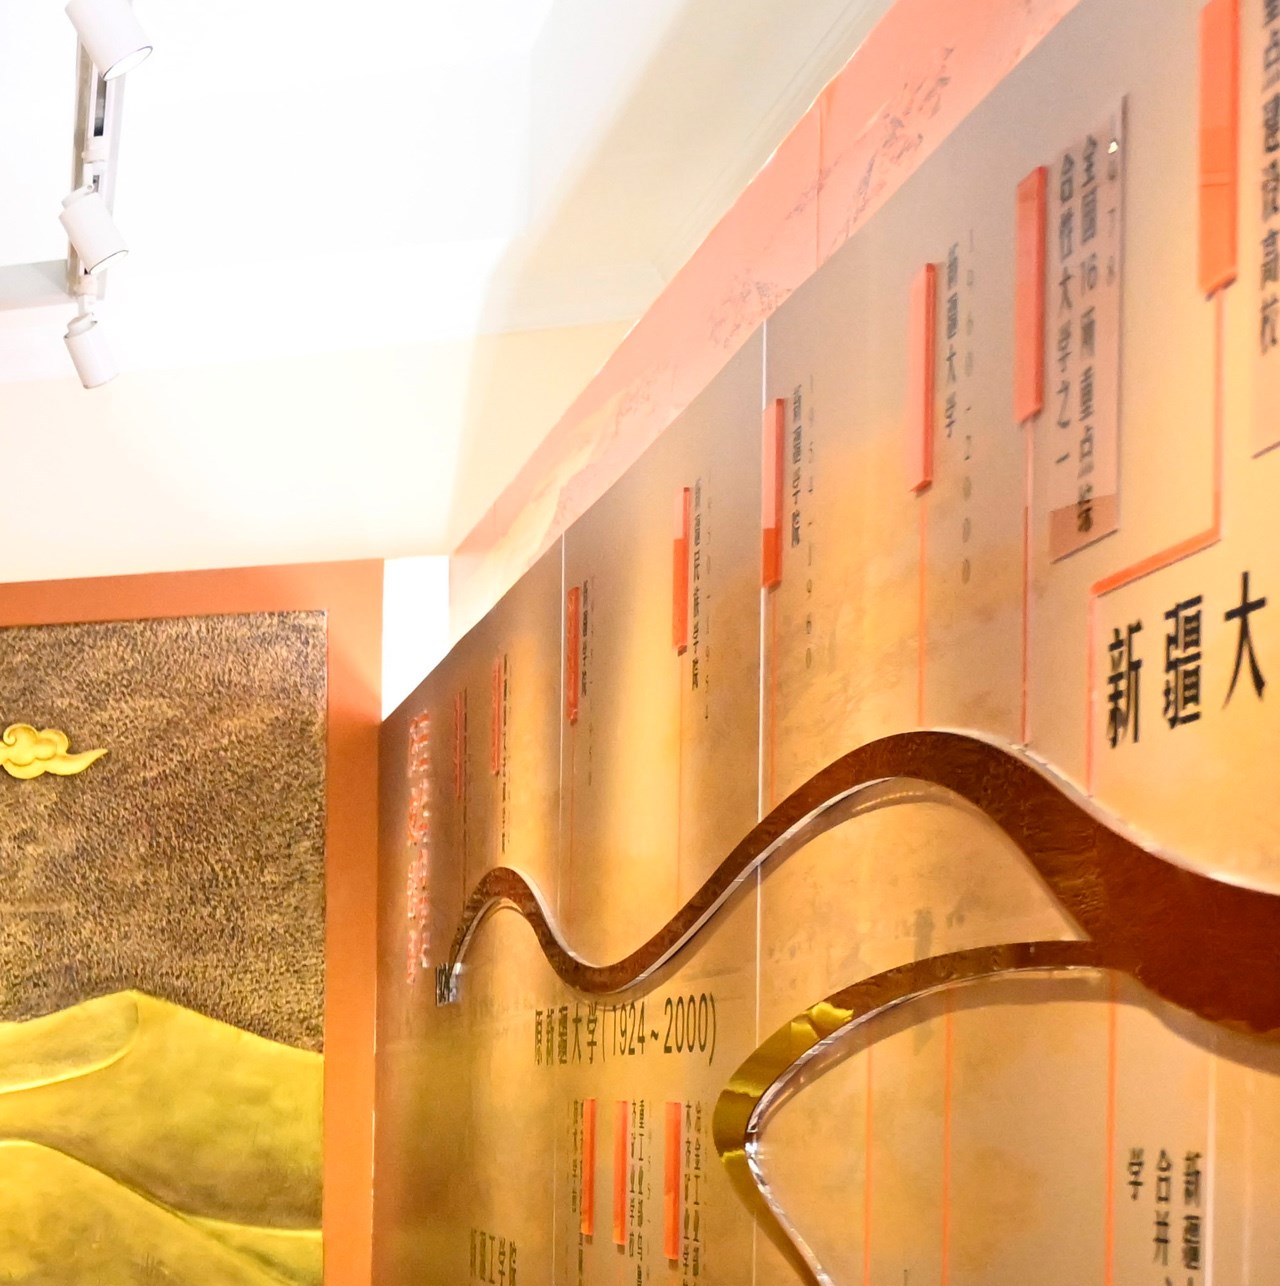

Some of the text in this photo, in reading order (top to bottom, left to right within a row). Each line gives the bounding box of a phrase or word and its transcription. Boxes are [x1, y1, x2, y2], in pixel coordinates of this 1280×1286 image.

[1106, 570, 1266, 748] 新疆大
[1128, 1148, 1144, 1200] 学
